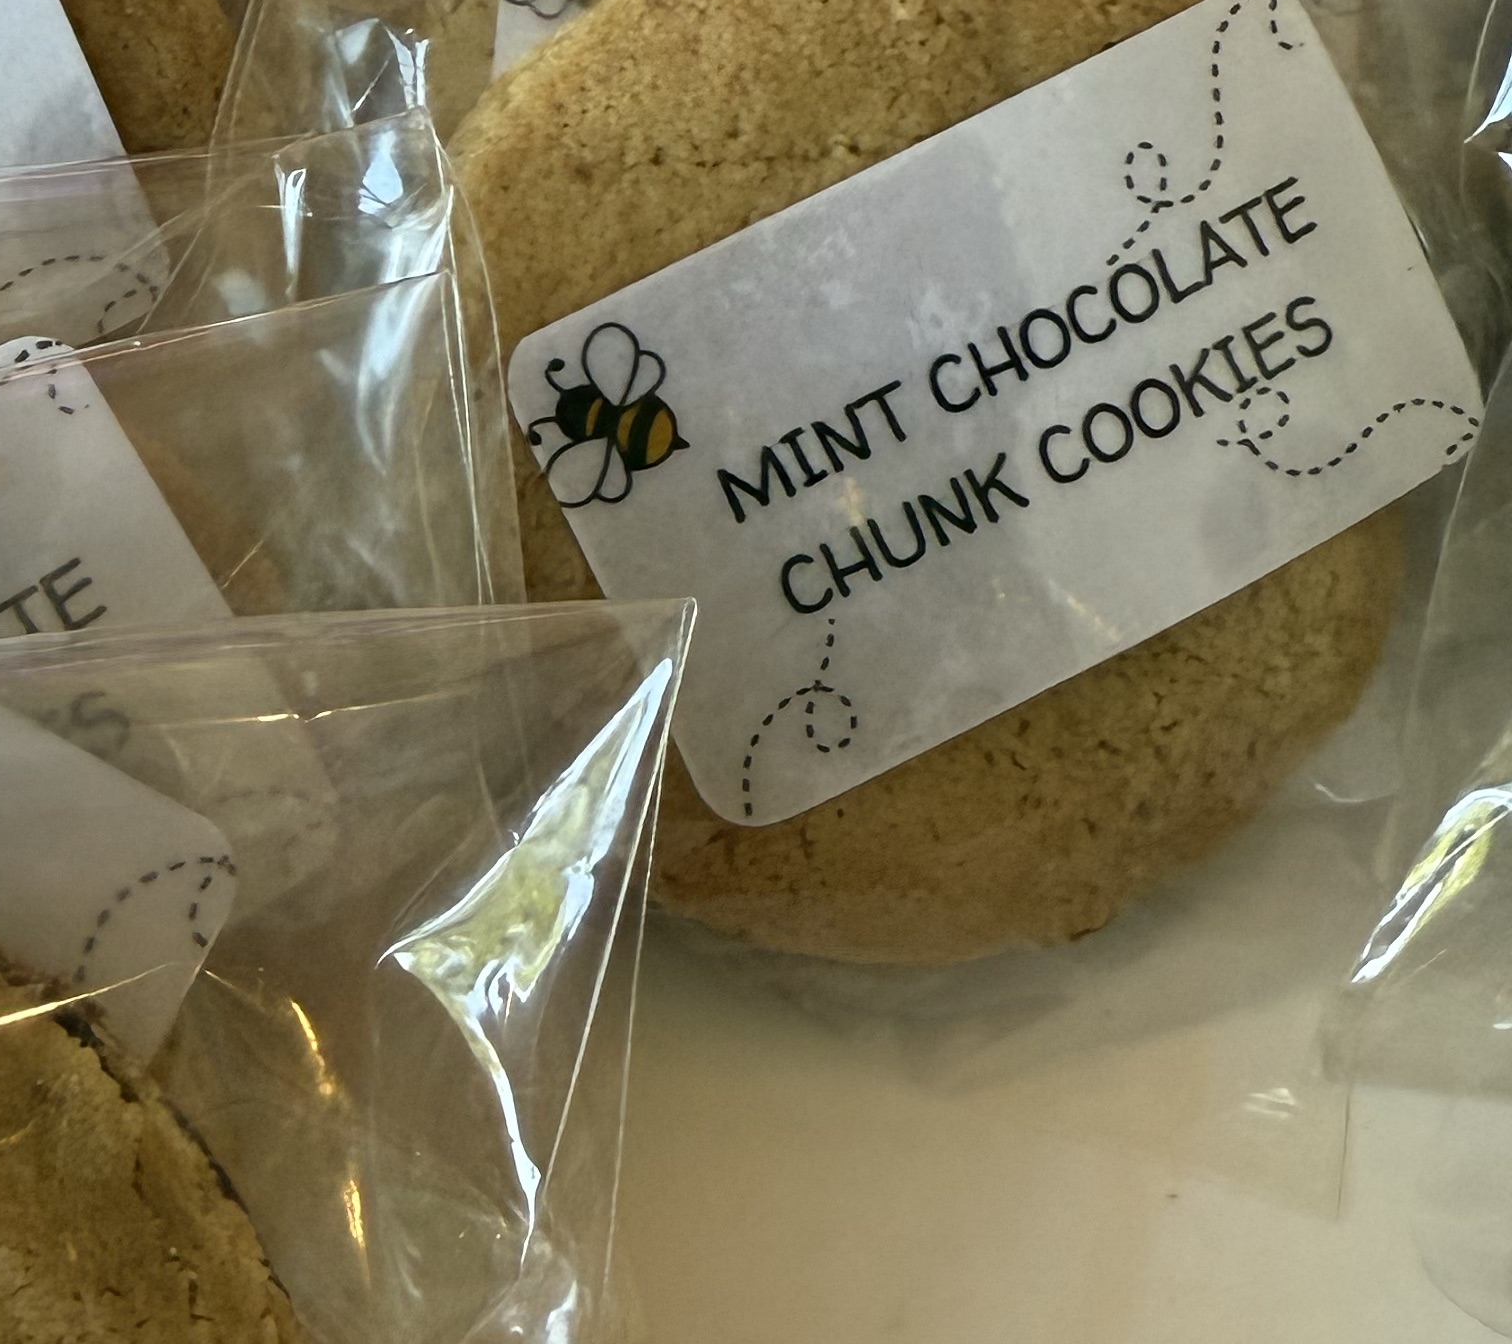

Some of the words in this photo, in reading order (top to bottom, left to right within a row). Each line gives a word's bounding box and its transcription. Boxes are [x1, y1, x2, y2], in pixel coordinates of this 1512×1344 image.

[717, 380, 907, 523] MINT
[929, 176, 1318, 413] CHOCOLATE
[780, 452, 1029, 614] CHUNK
[1038, 296, 1333, 484] COOKIES
